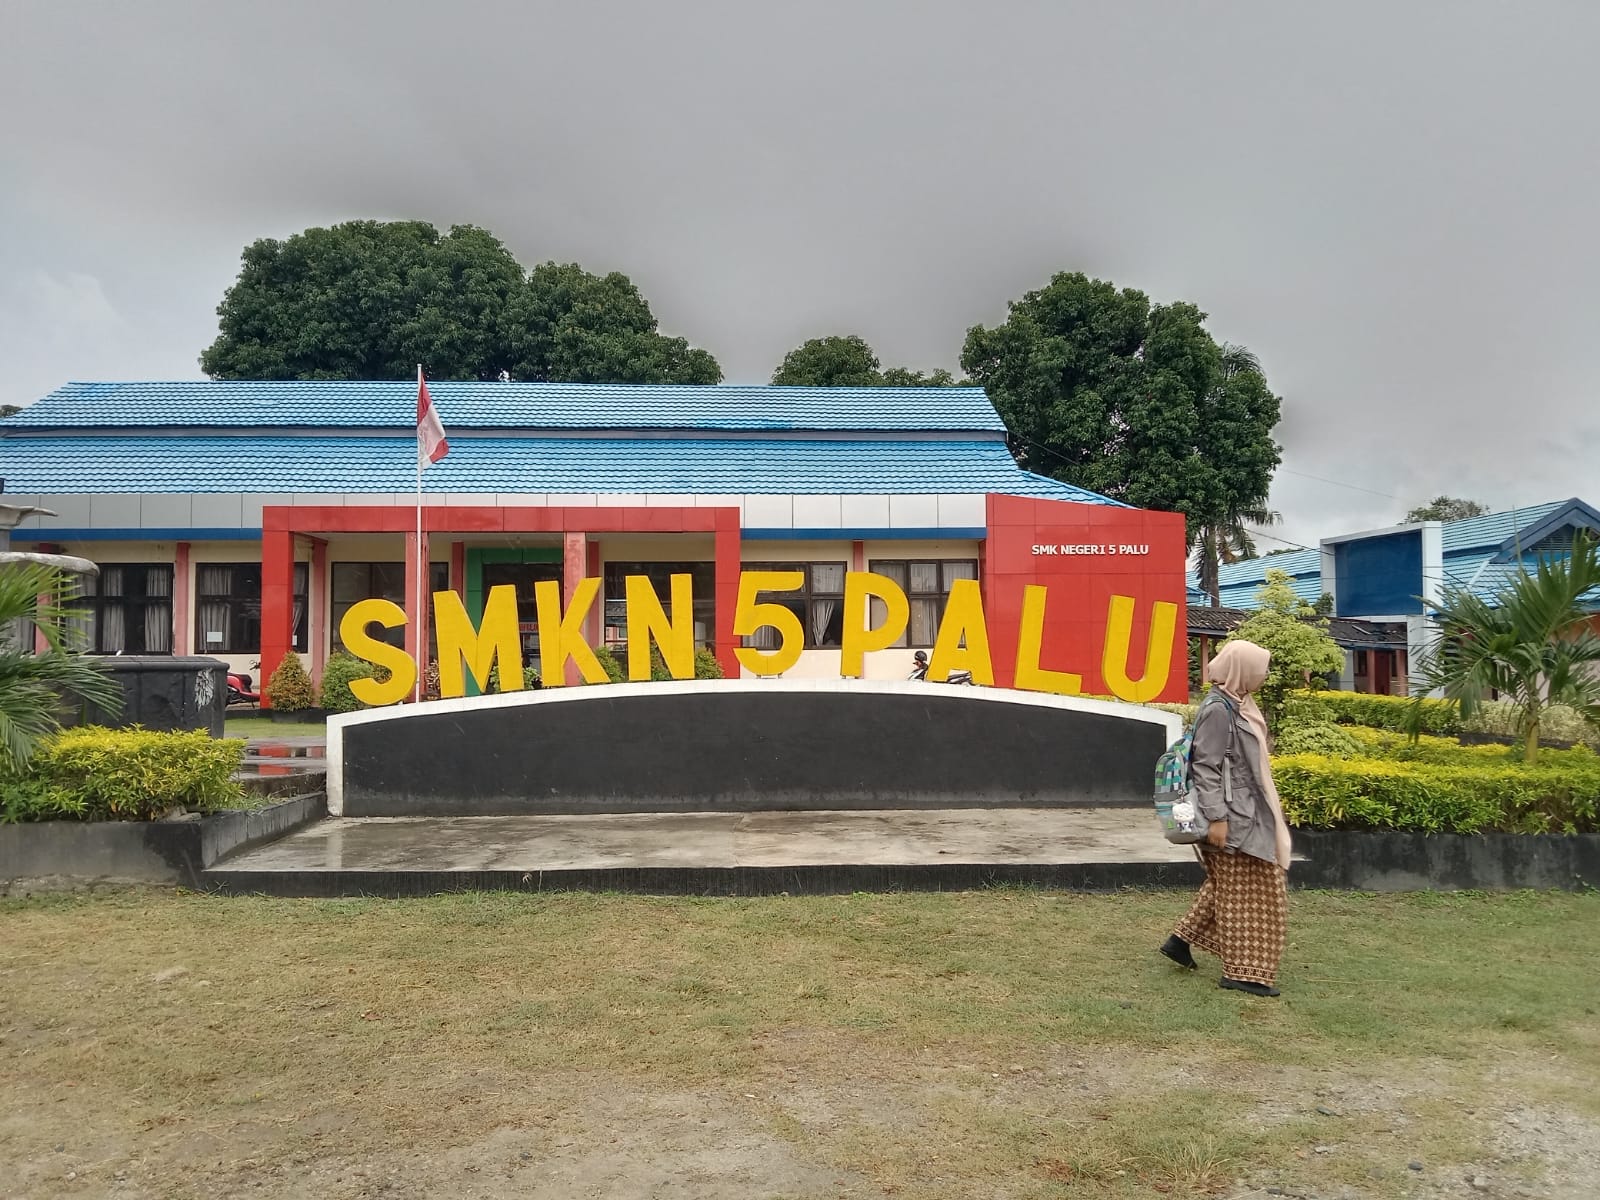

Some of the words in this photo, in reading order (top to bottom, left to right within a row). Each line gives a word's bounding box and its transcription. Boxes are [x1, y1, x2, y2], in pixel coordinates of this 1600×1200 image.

[1032, 545, 1057, 555] SMK
[1060, 545, 1105, 555] NEGERI
[1108, 545, 1116, 555] 5
[1119, 545, 1149, 555] PALU
[339, 573, 695, 706] SMKN
[733, 571, 804, 676] 5
[840, 571, 1178, 703] PALU
